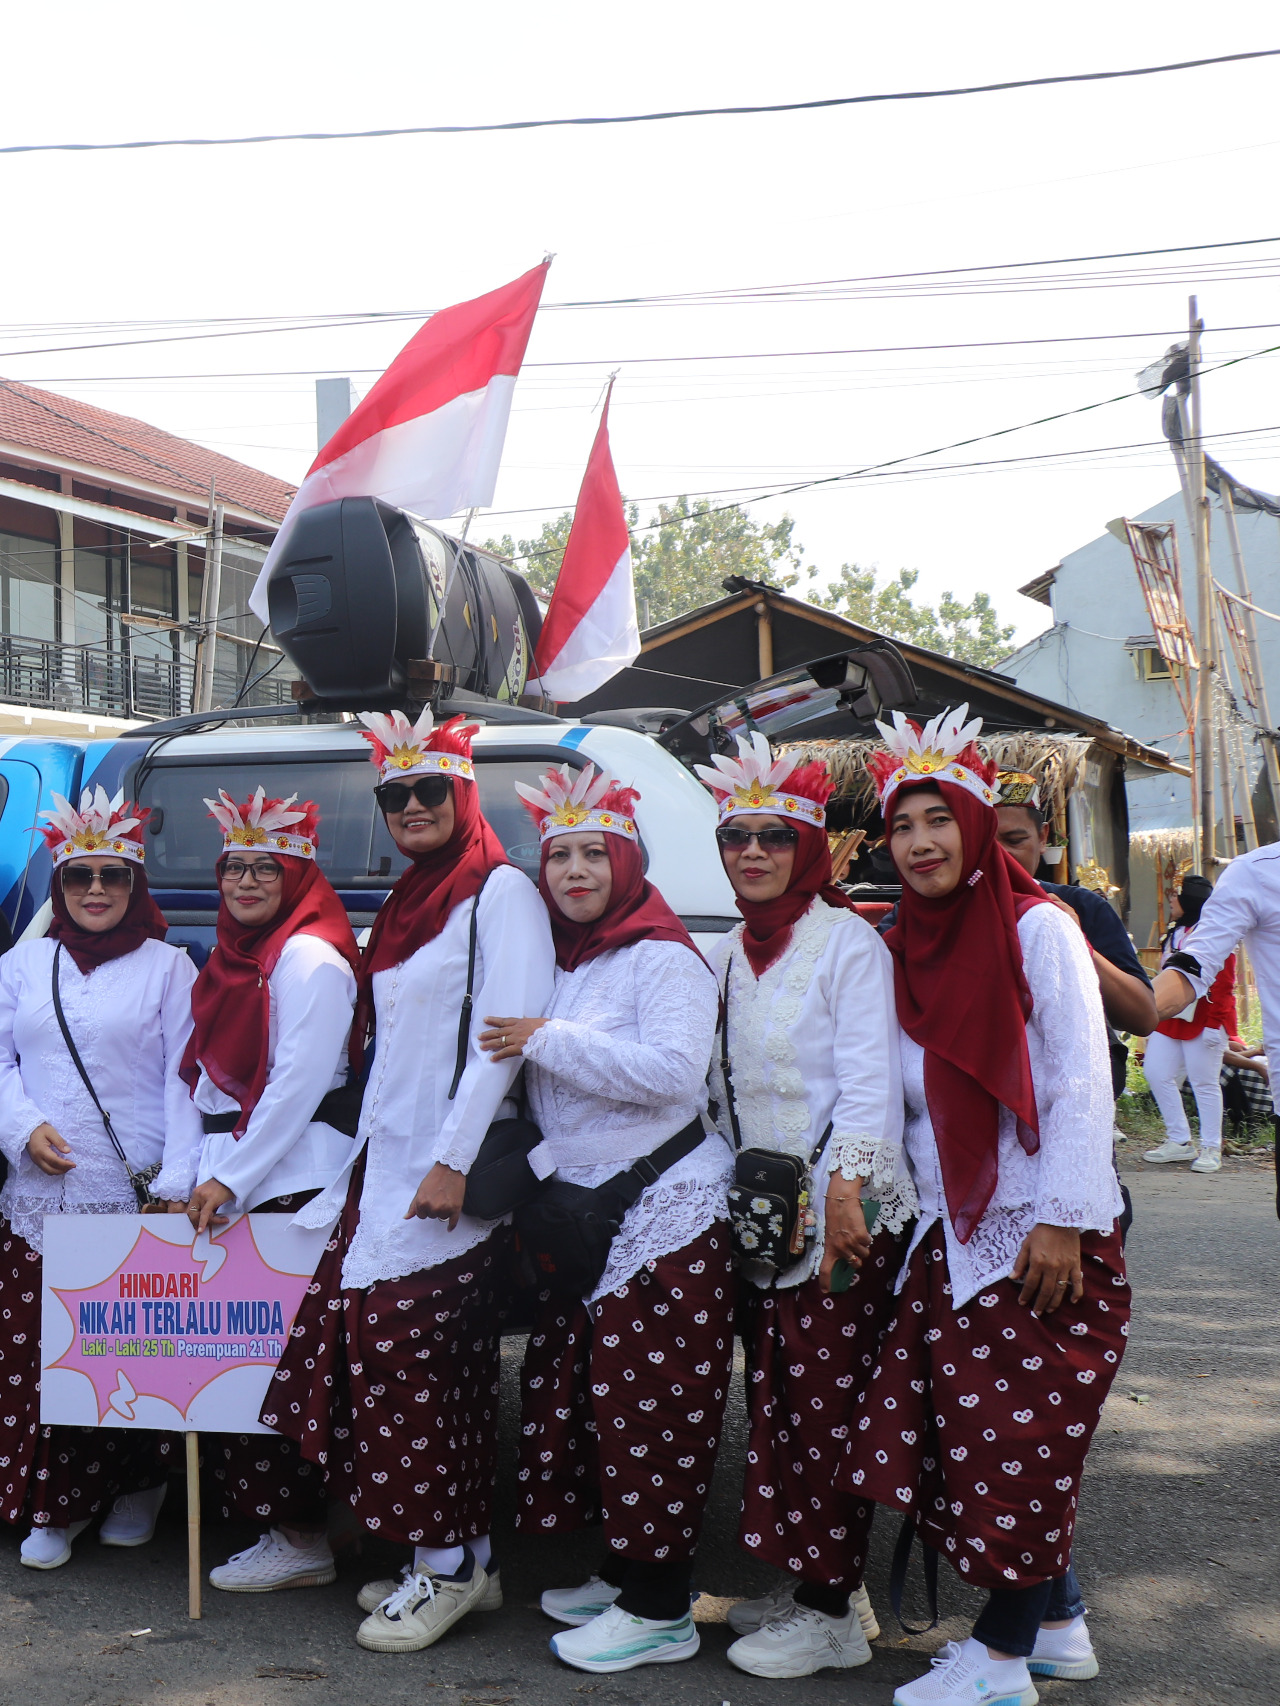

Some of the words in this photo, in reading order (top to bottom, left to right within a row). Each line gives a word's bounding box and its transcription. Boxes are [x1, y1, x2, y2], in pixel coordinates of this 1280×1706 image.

[119, 1273, 199, 1298] HINDARI
[79, 1301, 136, 1335] NIKAH
[141, 1301, 221, 1335] TERLALU
[226, 1300, 285, 1336] MUDA
[81, 1339, 106, 1356] Laki
[115, 1339, 141, 1357] Laki
[142, 1340, 159, 1357] 25
[160, 1339, 175, 1357] Th
[177, 1339, 247, 1361] Perempuan
[248, 1340, 266, 1357] 21
[267, 1340, 283, 1358] Th
